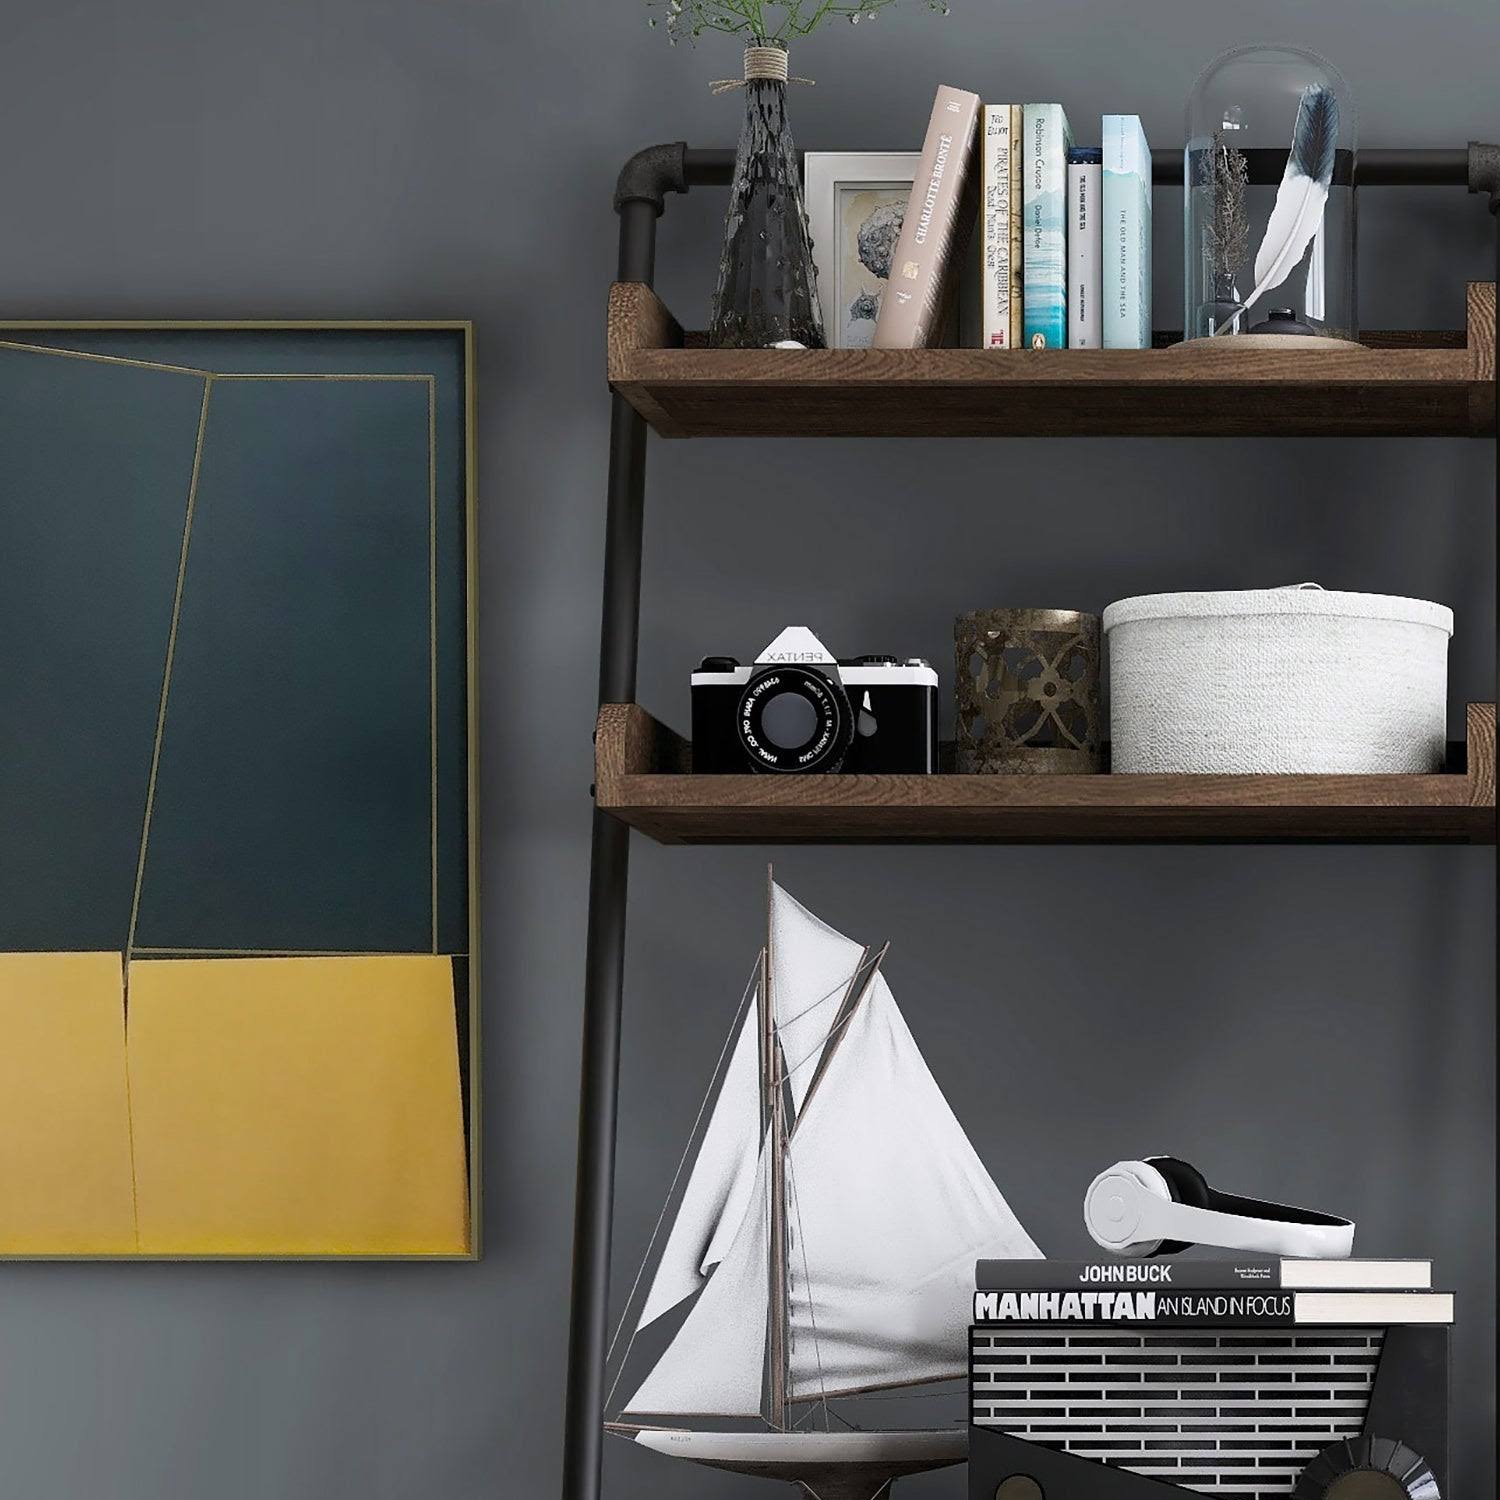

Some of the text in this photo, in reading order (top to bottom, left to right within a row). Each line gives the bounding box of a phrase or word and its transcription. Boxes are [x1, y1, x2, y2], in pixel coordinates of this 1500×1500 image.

[993, 147, 1009, 197] PIRATES
[1034, 117, 1046, 190] Robinson Crusoe
[914, 178, 942, 245] CHARLOTTE
[994, 199, 1009, 216] OF
[996, 219, 1009, 243] THE
[1034, 204, 1043, 249] Daniel Defoe
[993, 246, 1009, 316] CARIBBEAN
[1119, 209, 1127, 319] THE OLD MAN AND THE SEA
[1079, 1265, 1172, 1283] JOHN BUCK
[975, 1291, 1292, 1321] MANHATTAN AN ISLAND IN FOCUS
